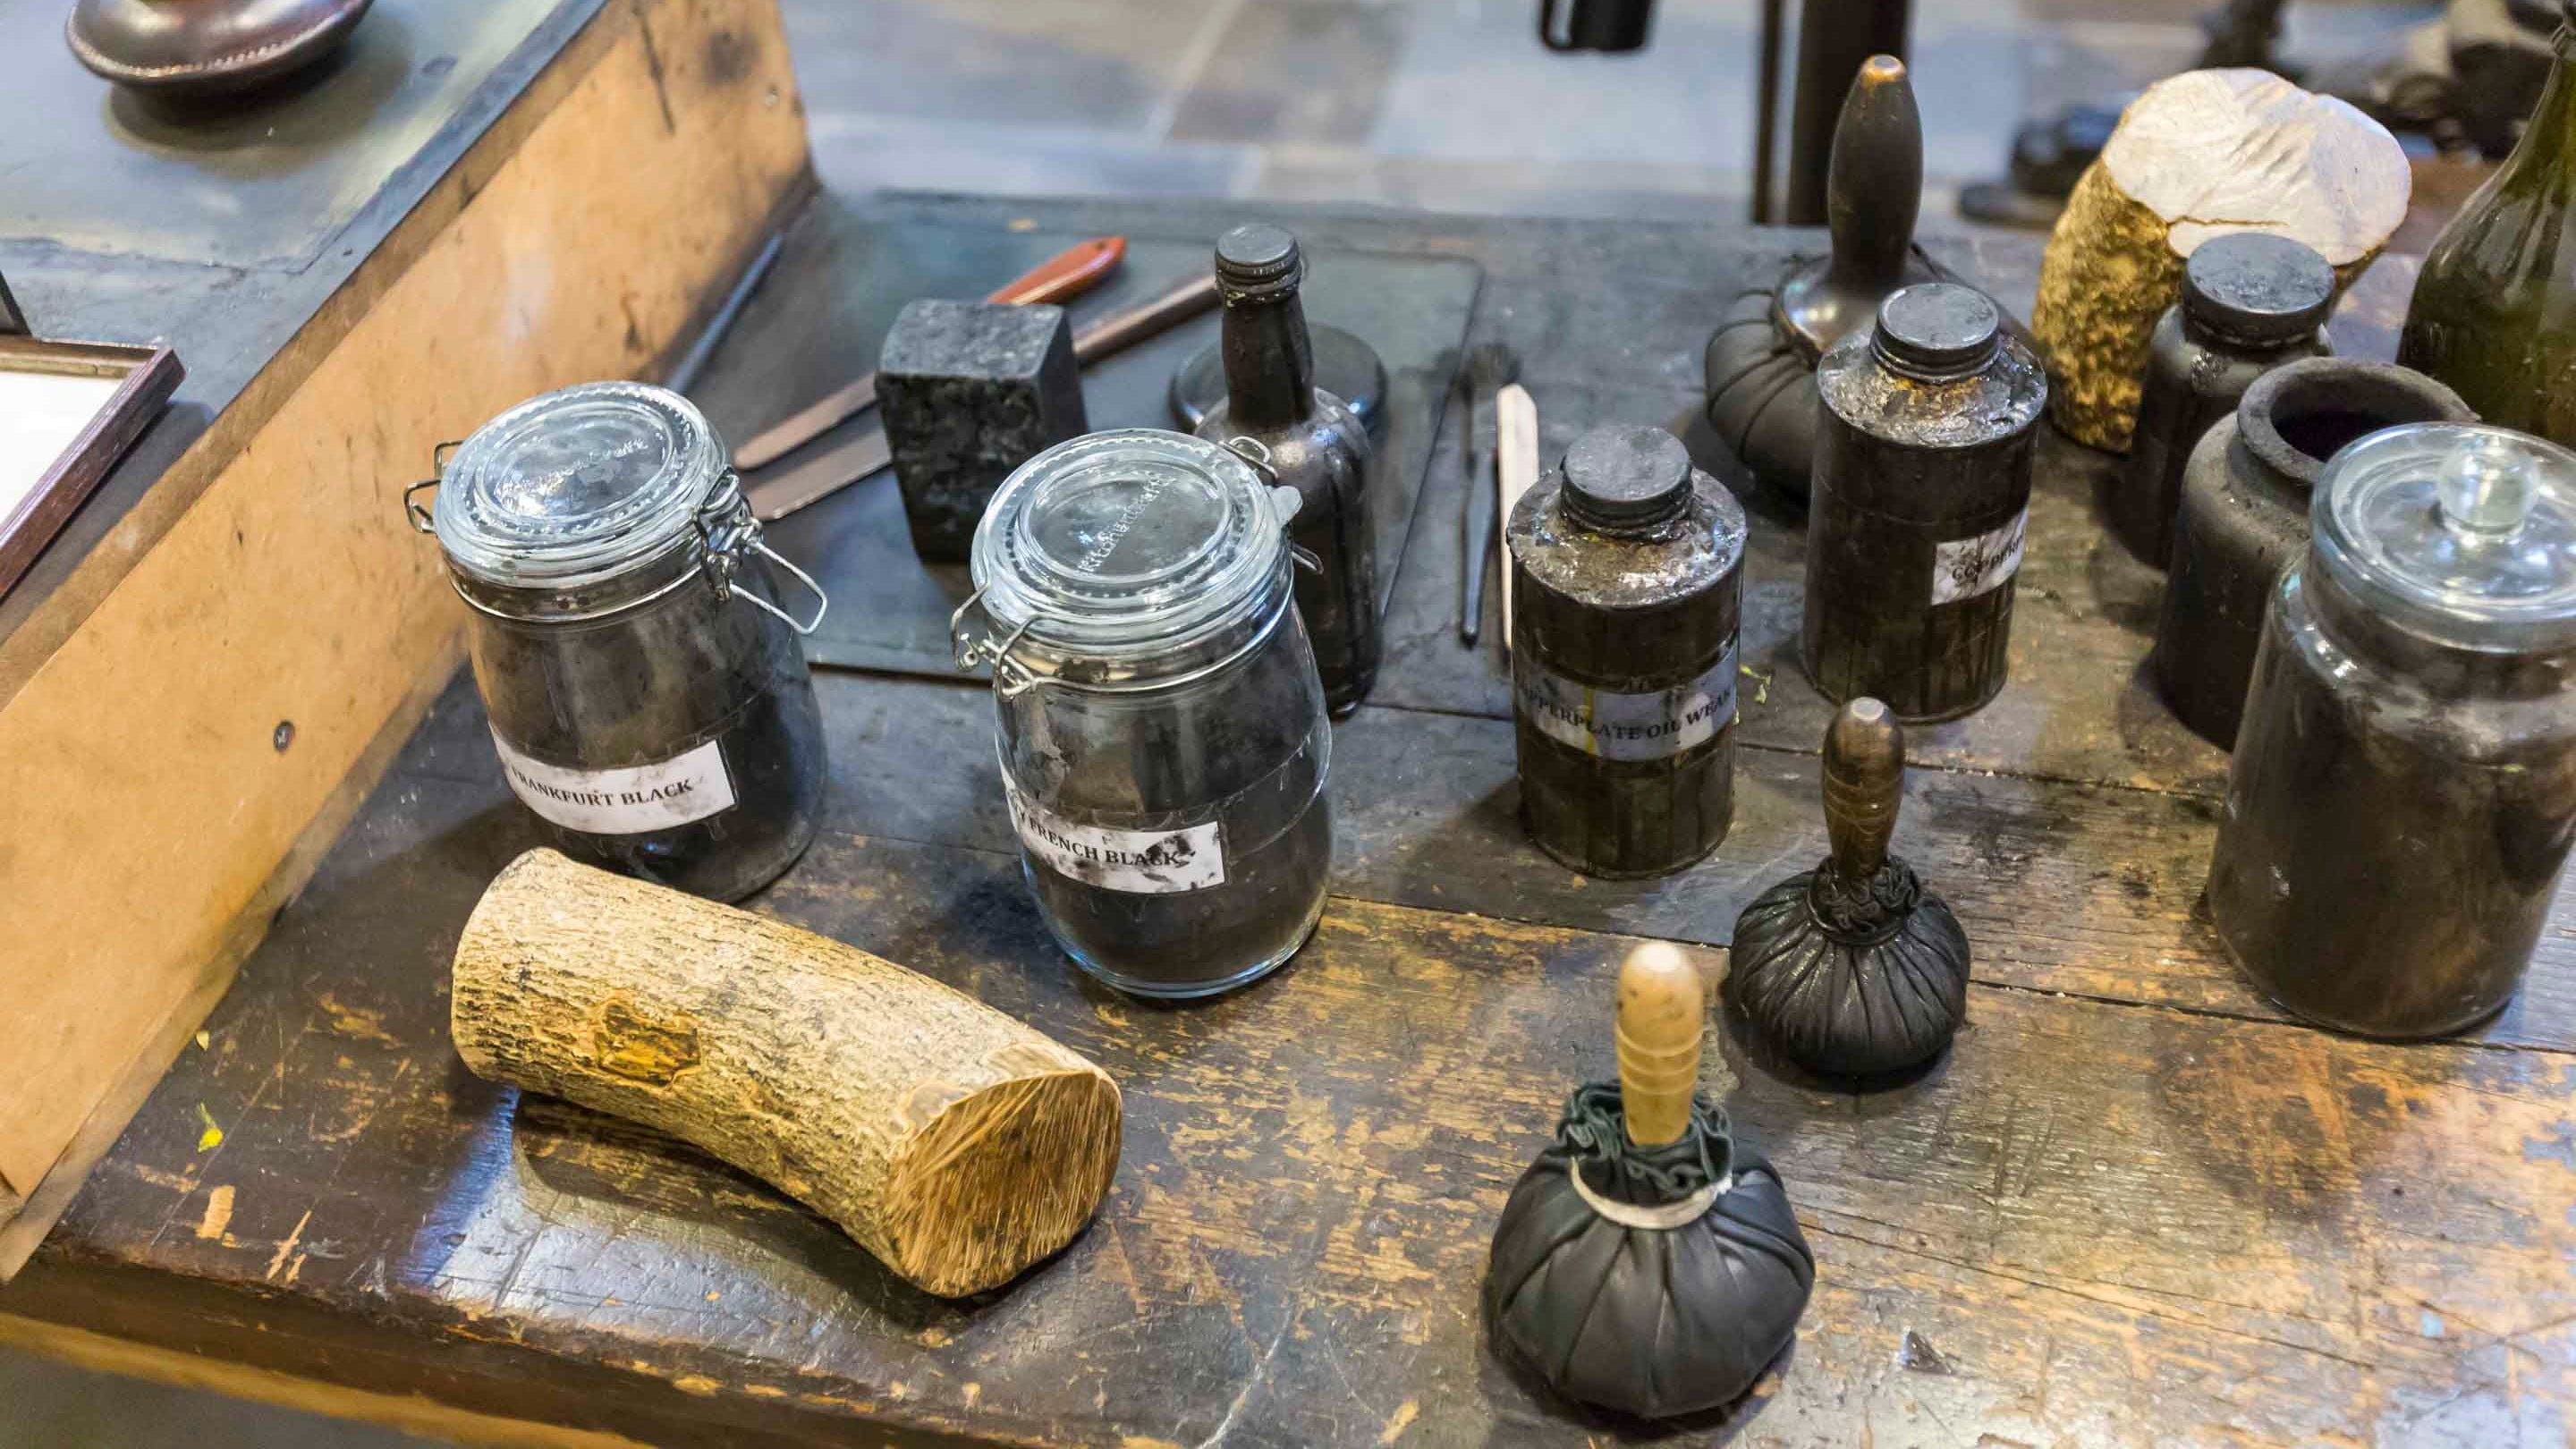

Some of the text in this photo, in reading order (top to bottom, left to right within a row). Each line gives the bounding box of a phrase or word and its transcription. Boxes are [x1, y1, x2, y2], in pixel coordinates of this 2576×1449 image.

[1647, 717, 1681, 740] OIL
[511, 762, 693, 806] FRANKFURT BLACK
[1029, 815, 1181, 868] FRENCH BLACK
